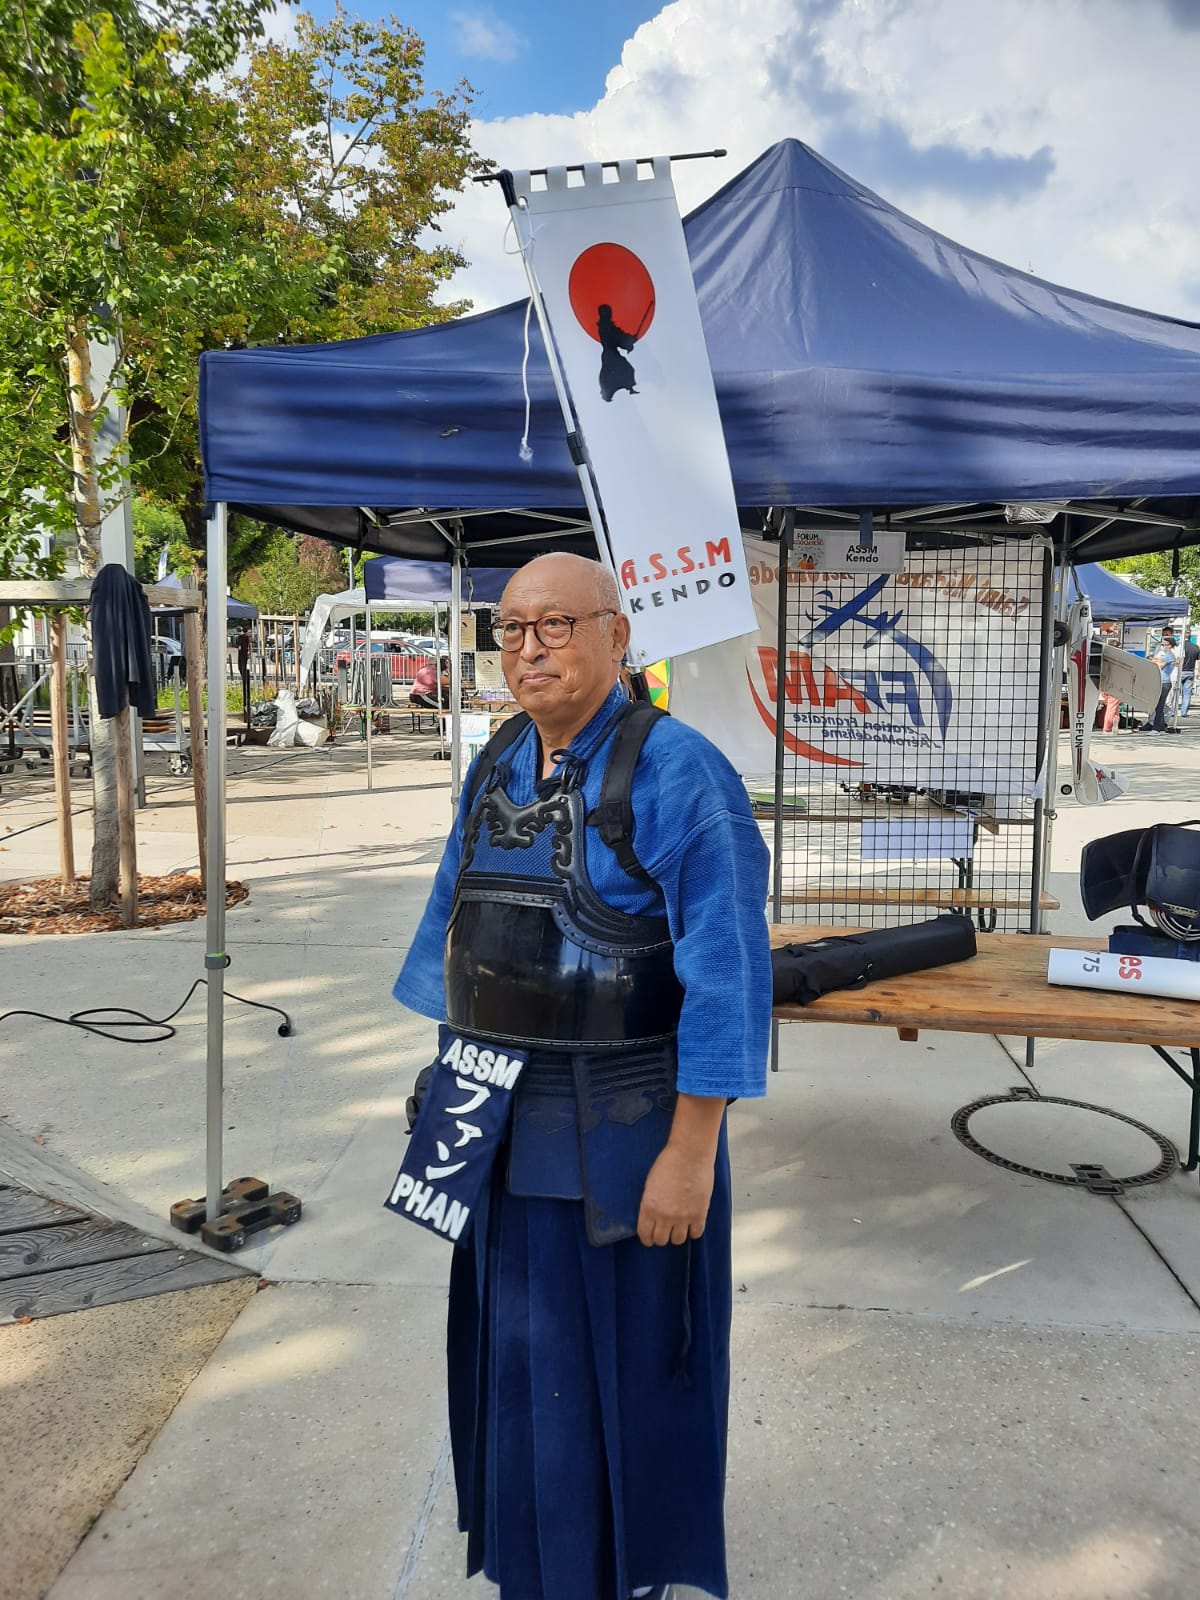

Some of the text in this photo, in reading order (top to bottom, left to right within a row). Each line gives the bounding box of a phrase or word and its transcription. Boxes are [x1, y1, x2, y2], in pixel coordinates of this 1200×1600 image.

[797, 532, 819, 541] FORUM
[847, 544, 878, 555] ASSM
[621, 537, 732, 591] A.S.S.M
[846, 554, 879, 563] Kendo
[630, 572, 736, 614] KENDO
[1074, 712, 1085, 748] D-EFUN
[441, 1038, 525, 1091] ASSM
[425, 1076, 491, 1181] ファン
[390, 1172, 470, 1242] PHAN
